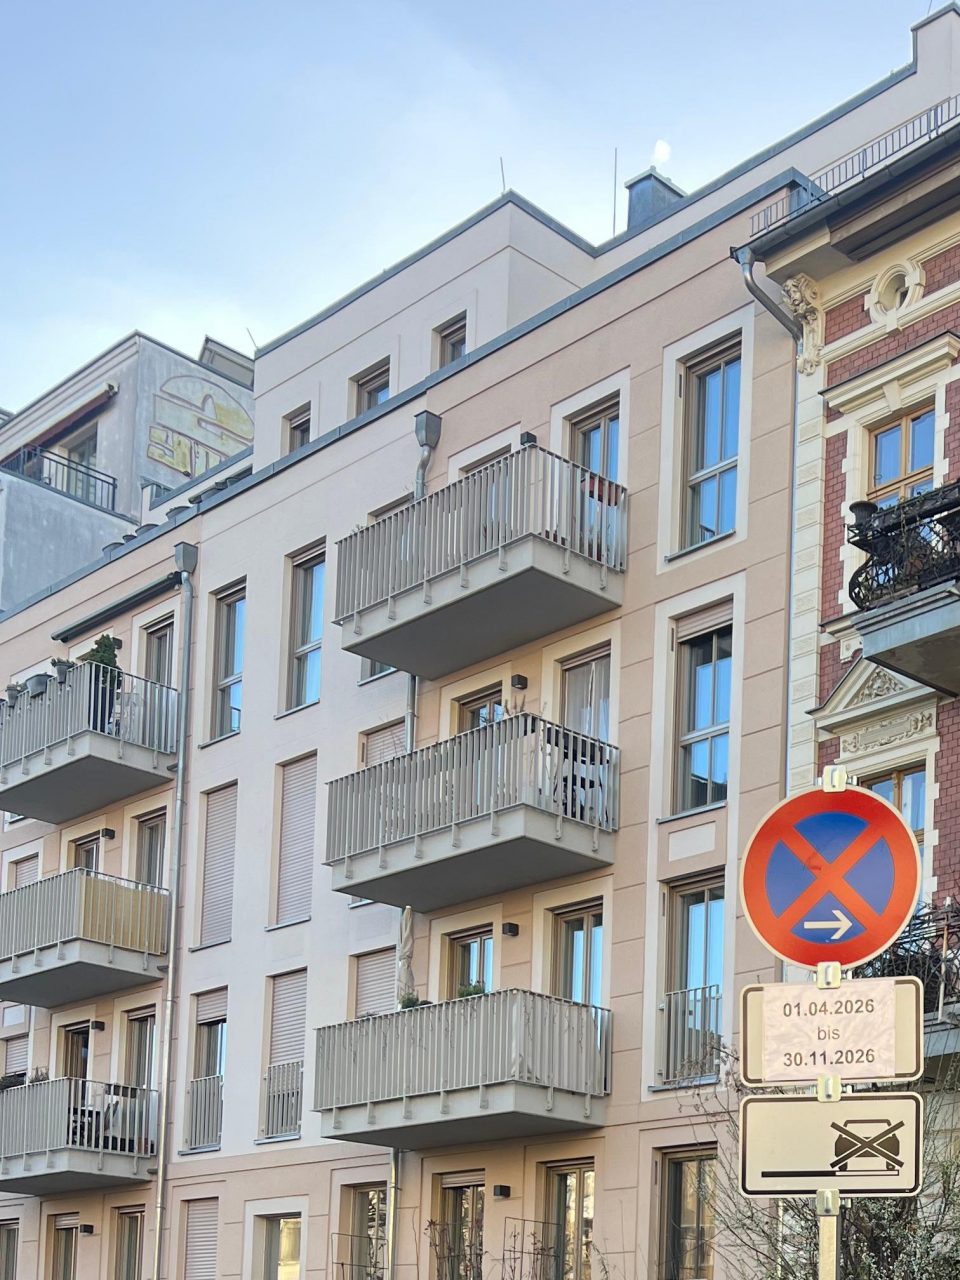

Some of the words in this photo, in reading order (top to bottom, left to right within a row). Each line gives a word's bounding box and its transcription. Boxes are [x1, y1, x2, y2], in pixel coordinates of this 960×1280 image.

[783, 999, 875, 1017] 01.04.2026
[817, 1026, 841, 1041] bis
[783, 1048, 876, 1067] 30.11.2026
